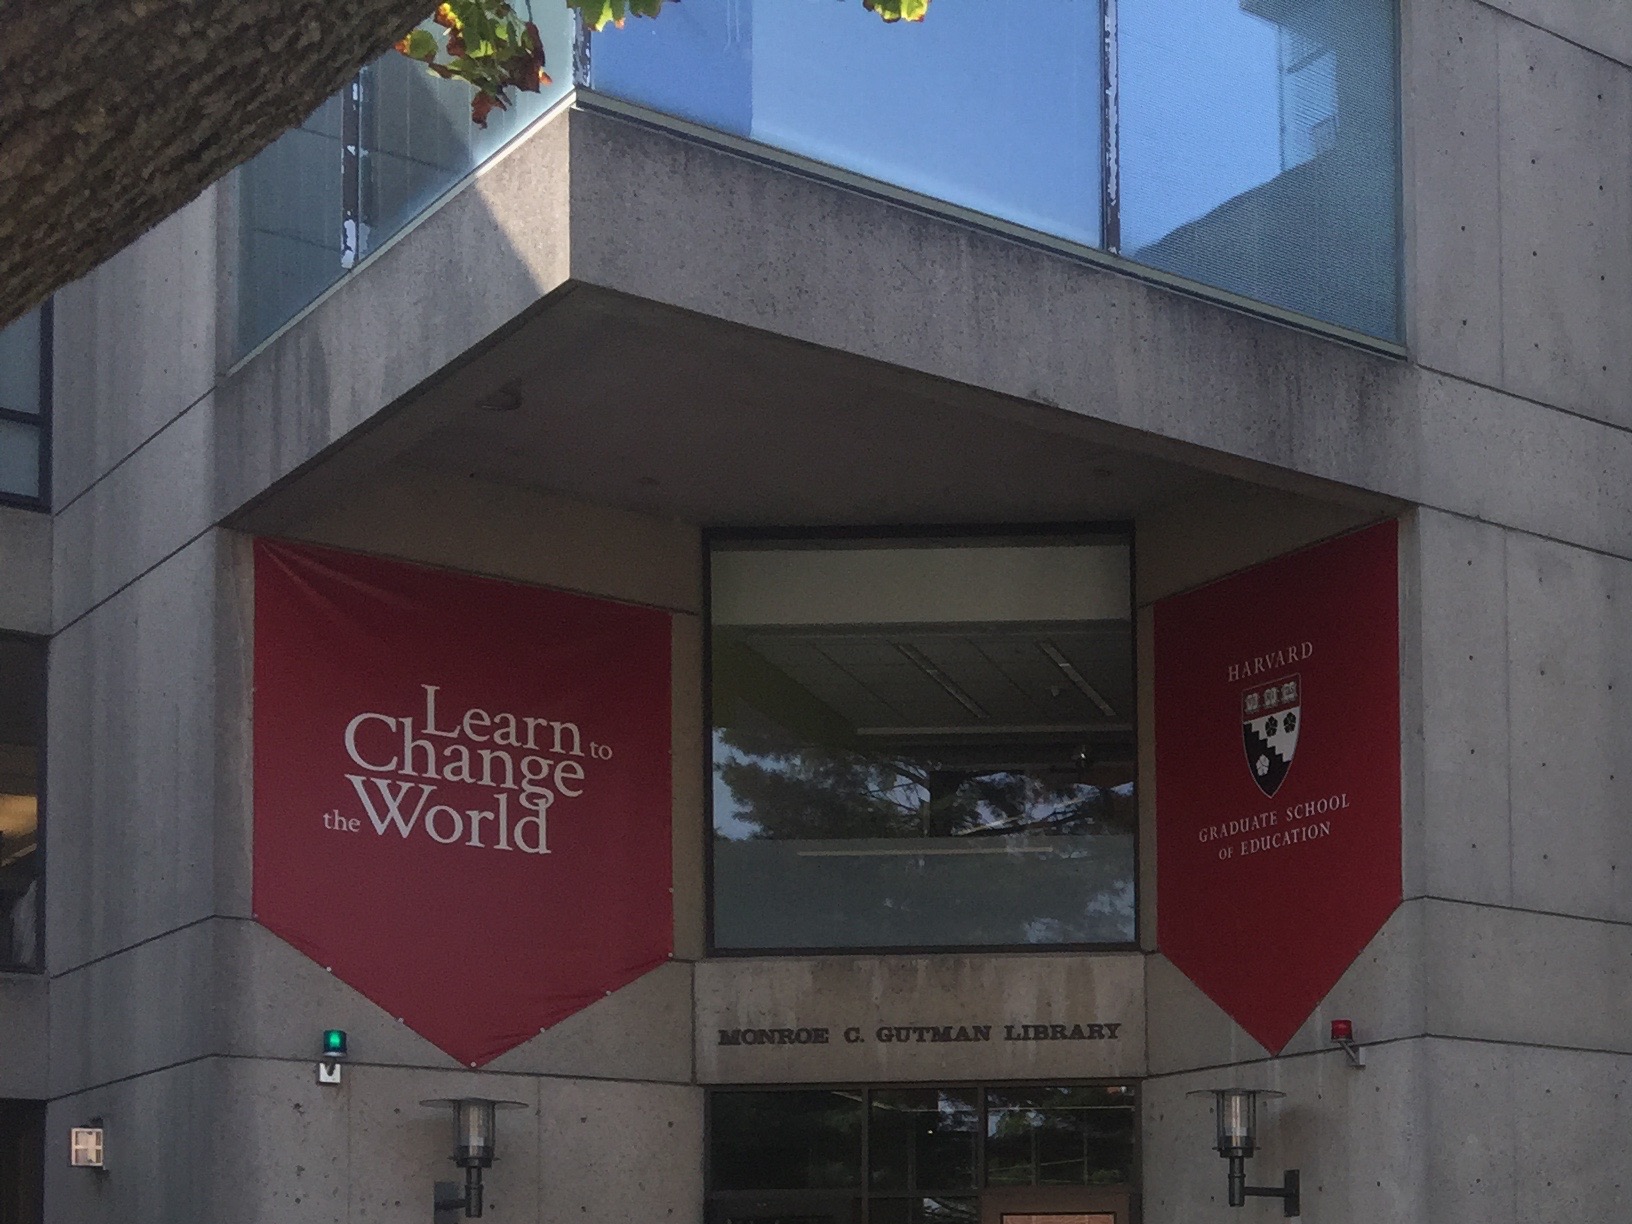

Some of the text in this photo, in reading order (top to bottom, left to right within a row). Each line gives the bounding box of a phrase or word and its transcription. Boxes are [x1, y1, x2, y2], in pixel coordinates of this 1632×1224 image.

[1227, 641, 1313, 683] HARVARD
[420, 683, 613, 760] Learn to
[344, 712, 585, 811] Change
[322, 773, 552, 855] the World
[1199, 793, 1350, 843] GRADUATE SCHOOL
[1218, 820, 1331, 861] OF EDUCATION
[718, 1022, 1122, 1046] MONROE C. GUTMAN LIBRARY
